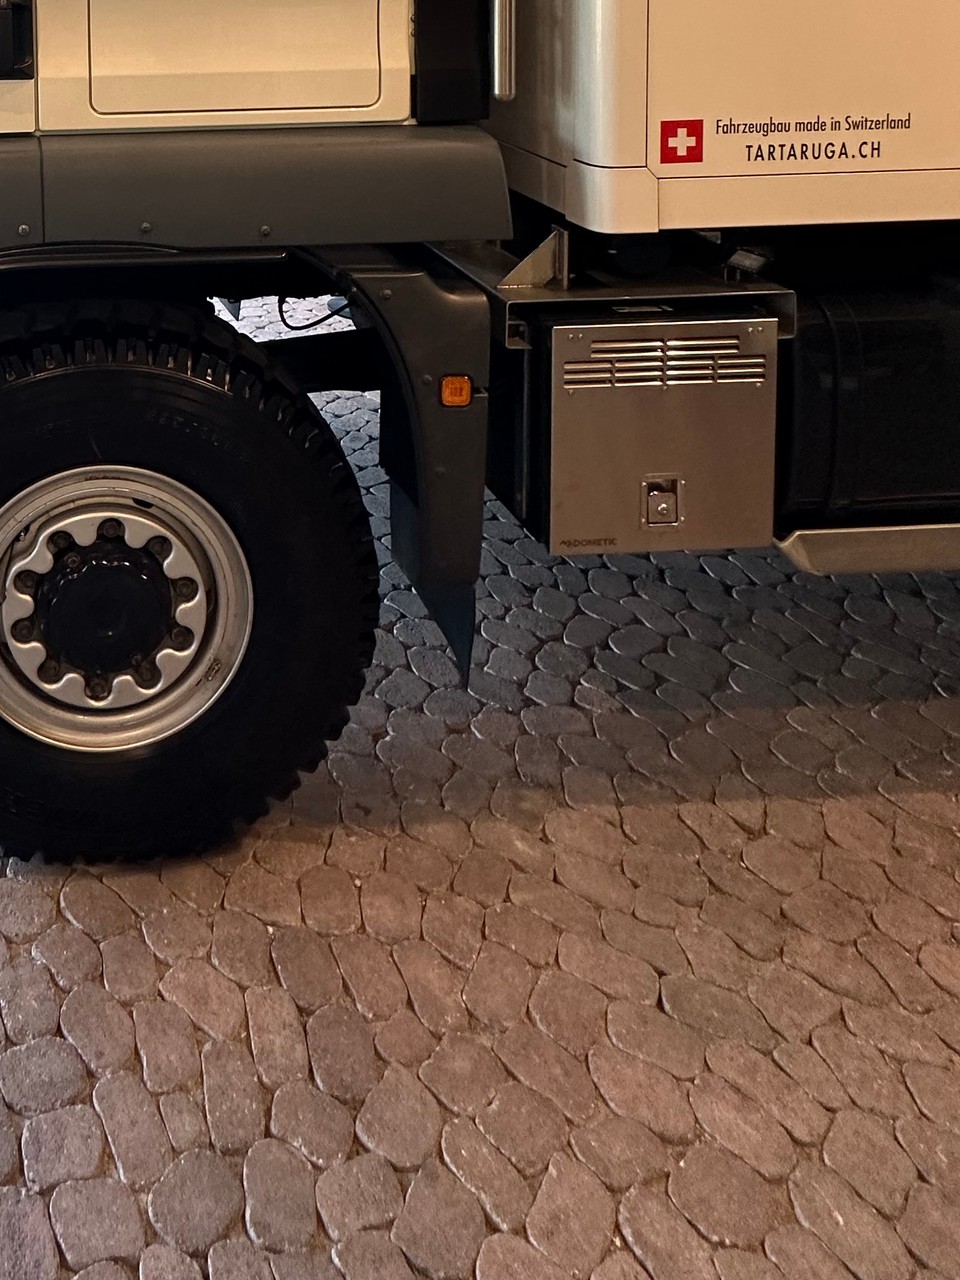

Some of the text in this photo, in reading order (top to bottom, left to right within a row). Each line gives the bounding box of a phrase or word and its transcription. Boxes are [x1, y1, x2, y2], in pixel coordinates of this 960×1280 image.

[716, 113, 911, 137] Fahrzeugbau made in Switzerland
[746, 141, 881, 162] TARTARUGA.CH
[572, 538, 618, 548] DOMETIC
